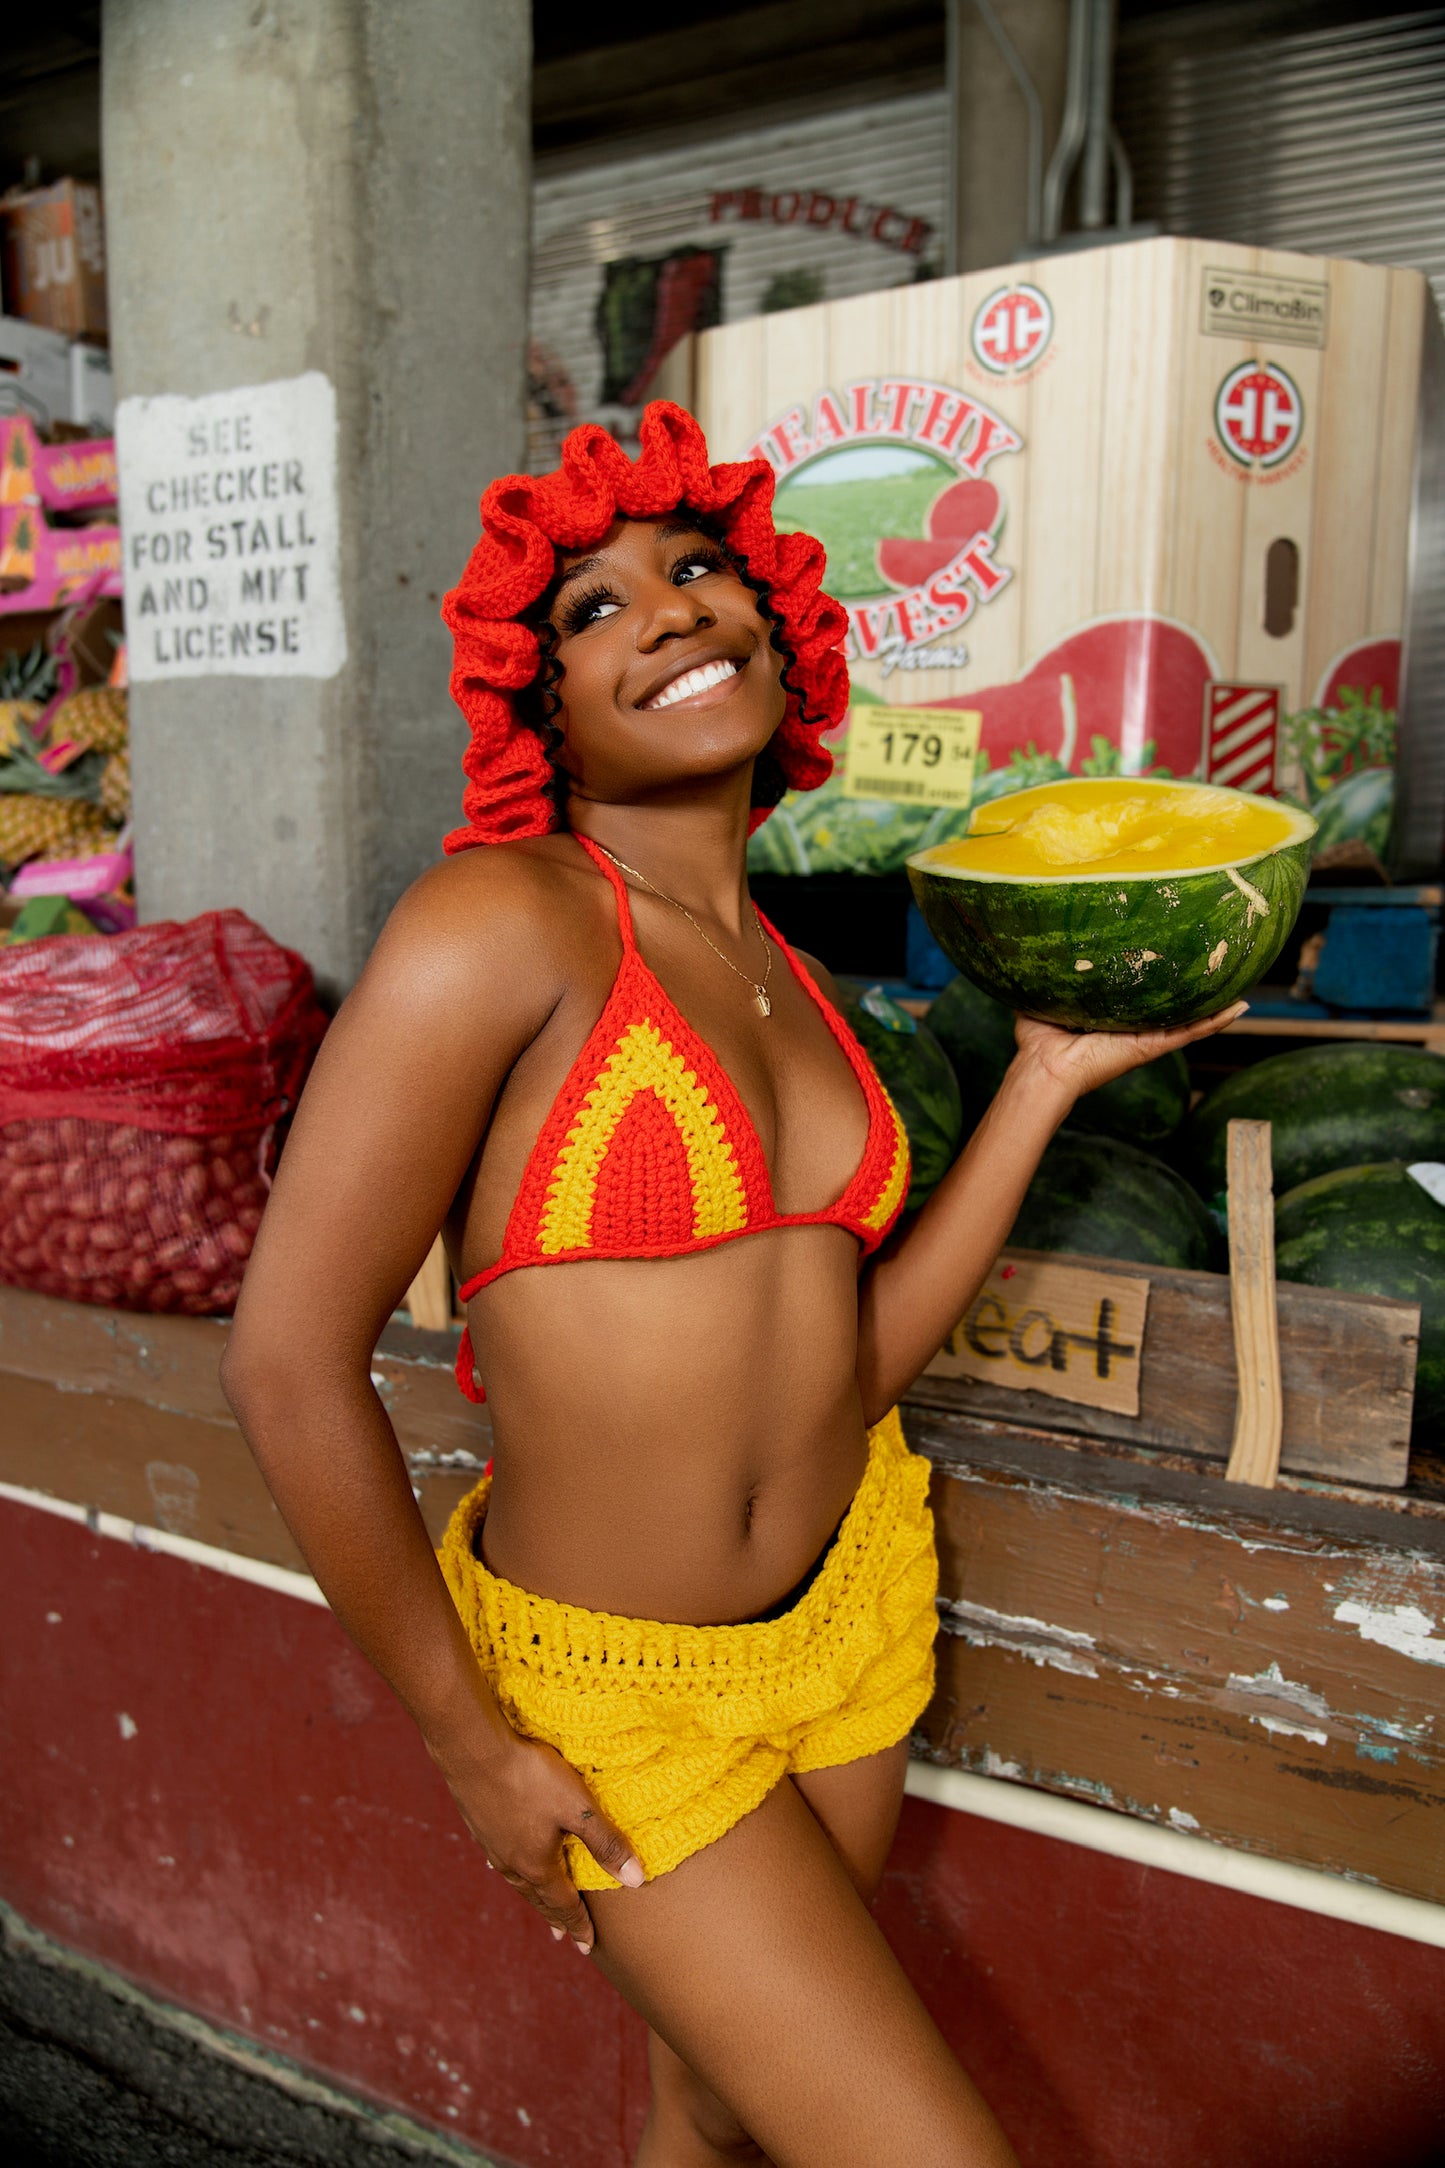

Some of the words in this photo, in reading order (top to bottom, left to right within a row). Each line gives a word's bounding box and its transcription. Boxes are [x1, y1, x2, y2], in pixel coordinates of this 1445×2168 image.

[706, 184, 932, 257] PRODUCE
[188, 415, 253, 457] SEE
[744, 379, 1022, 476] EALTHY
[146, 460, 305, 515] CHECKER
[131, 530, 192, 569] FOR
[207, 510, 316, 559] STALL
[138, 577, 209, 617] AND
[838, 534, 1013, 658] VEST
[154, 617, 299, 663] LICENSE
[878, 634, 969, 679] Farms
[881, 731, 942, 767] 179
[944, 1296, 1136, 1378] eat
